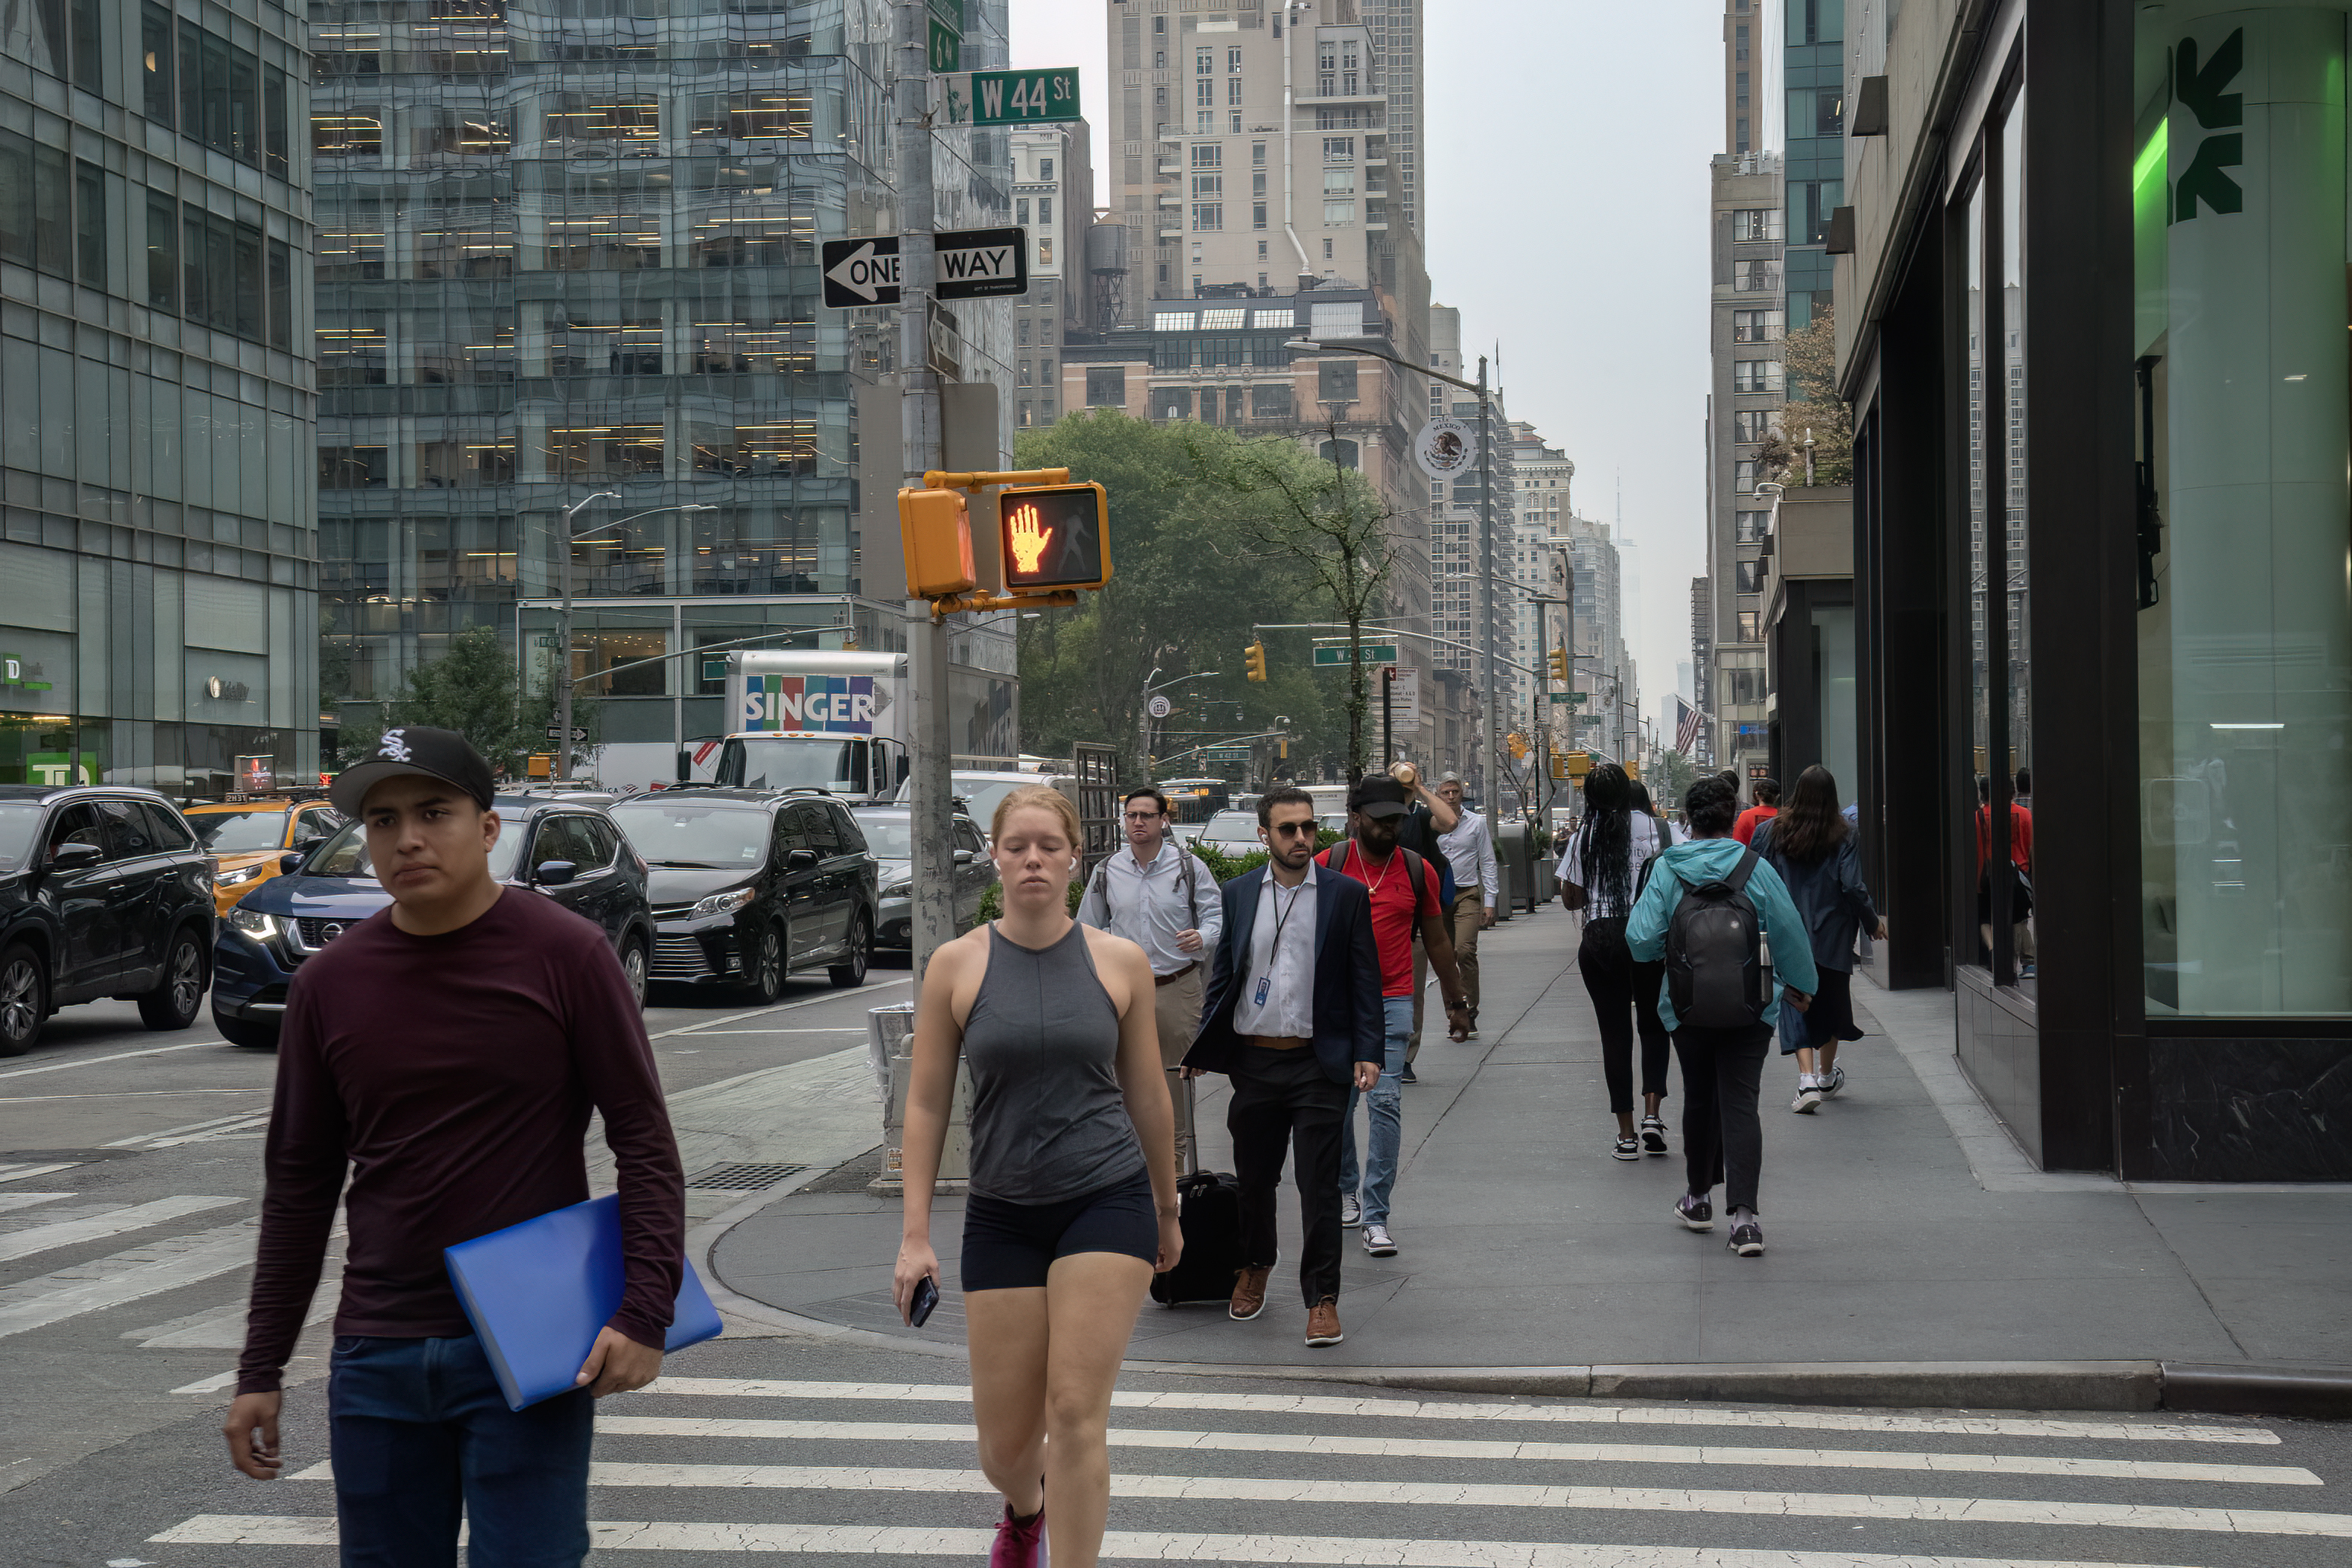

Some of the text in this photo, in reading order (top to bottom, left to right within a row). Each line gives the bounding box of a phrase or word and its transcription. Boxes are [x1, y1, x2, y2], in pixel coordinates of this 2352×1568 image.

[936, 31, 942, 69] 6
[981, 76, 1071, 118] W 44 St
[850, 249, 1007, 285] ONE WAY
[1433, 423, 1461, 432] MEXICO
[1337, 650, 1344, 661] W
[1365, 649, 1375, 660] St
[746, 692, 874, 722] SINGER
[227, 795, 246, 803] 2H31
